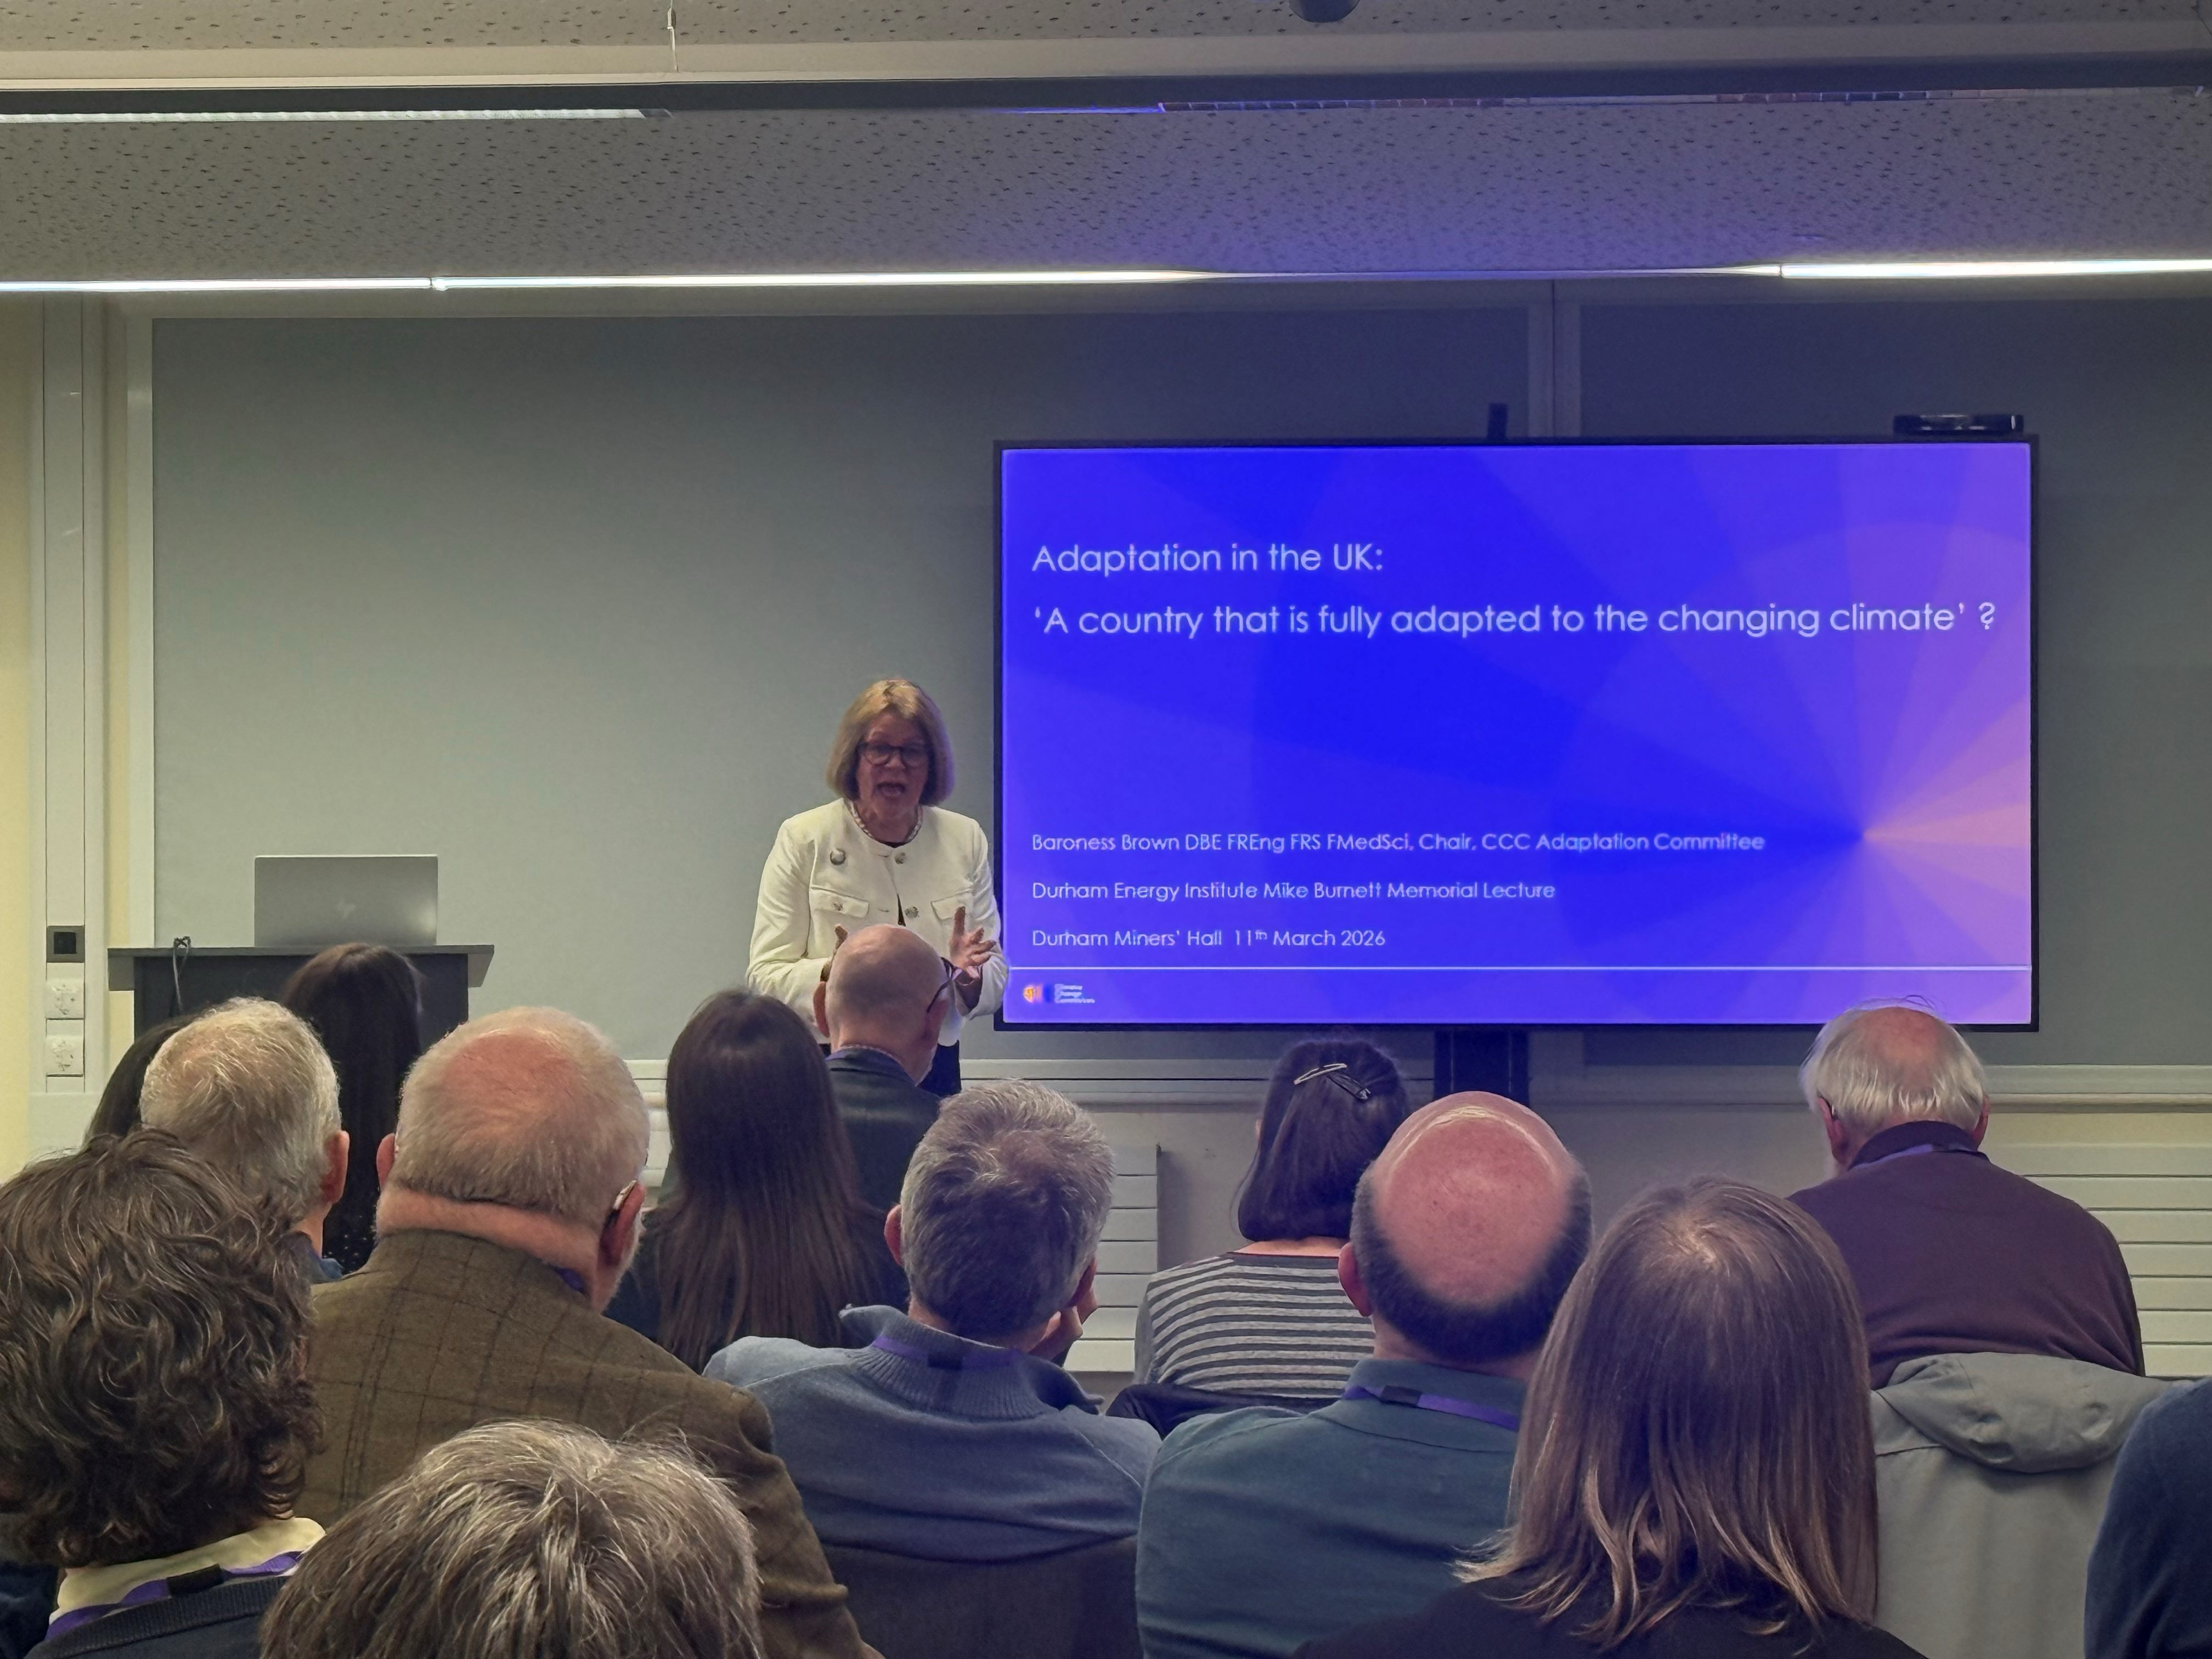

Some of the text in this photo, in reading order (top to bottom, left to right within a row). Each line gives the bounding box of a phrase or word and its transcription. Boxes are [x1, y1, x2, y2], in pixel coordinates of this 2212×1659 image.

[1031, 543, 1384, 578] Adaptation in the UK:
[1078, 606, 1204, 640] country
[1212, 605, 1280, 634] that
[1289, 605, 1309, 633] is
[1318, 604, 1383, 639] fully
[1391, 604, 1541, 639] adapted
[1551, 605, 1585, 633] to
[1593, 604, 1649, 632] the
[1658, 602, 1820, 638] changing
[1978, 602, 1995, 630] ?
[1032, 834, 1116, 851] Baroness
[1121, 833, 1180, 851] Brown
[1185, 833, 1222, 851] DBE
[1227, 833, 1285, 854] FREng
[1290, 833, 1322, 850] FRS
[1481, 833, 1531, 851] CCC
[1535, 832, 1649, 854] Adaptation
[1653, 833, 1765, 851] Committee
[1032, 882, 1556, 902] Durham Energy Institute Mike Burnett Memorial Lecture
[1032, 930, 1108, 946] Durham
[1187, 930, 1222, 946] Hall
[1273, 929, 1336, 946] March
[1341, 930, 1386, 946] 2026
